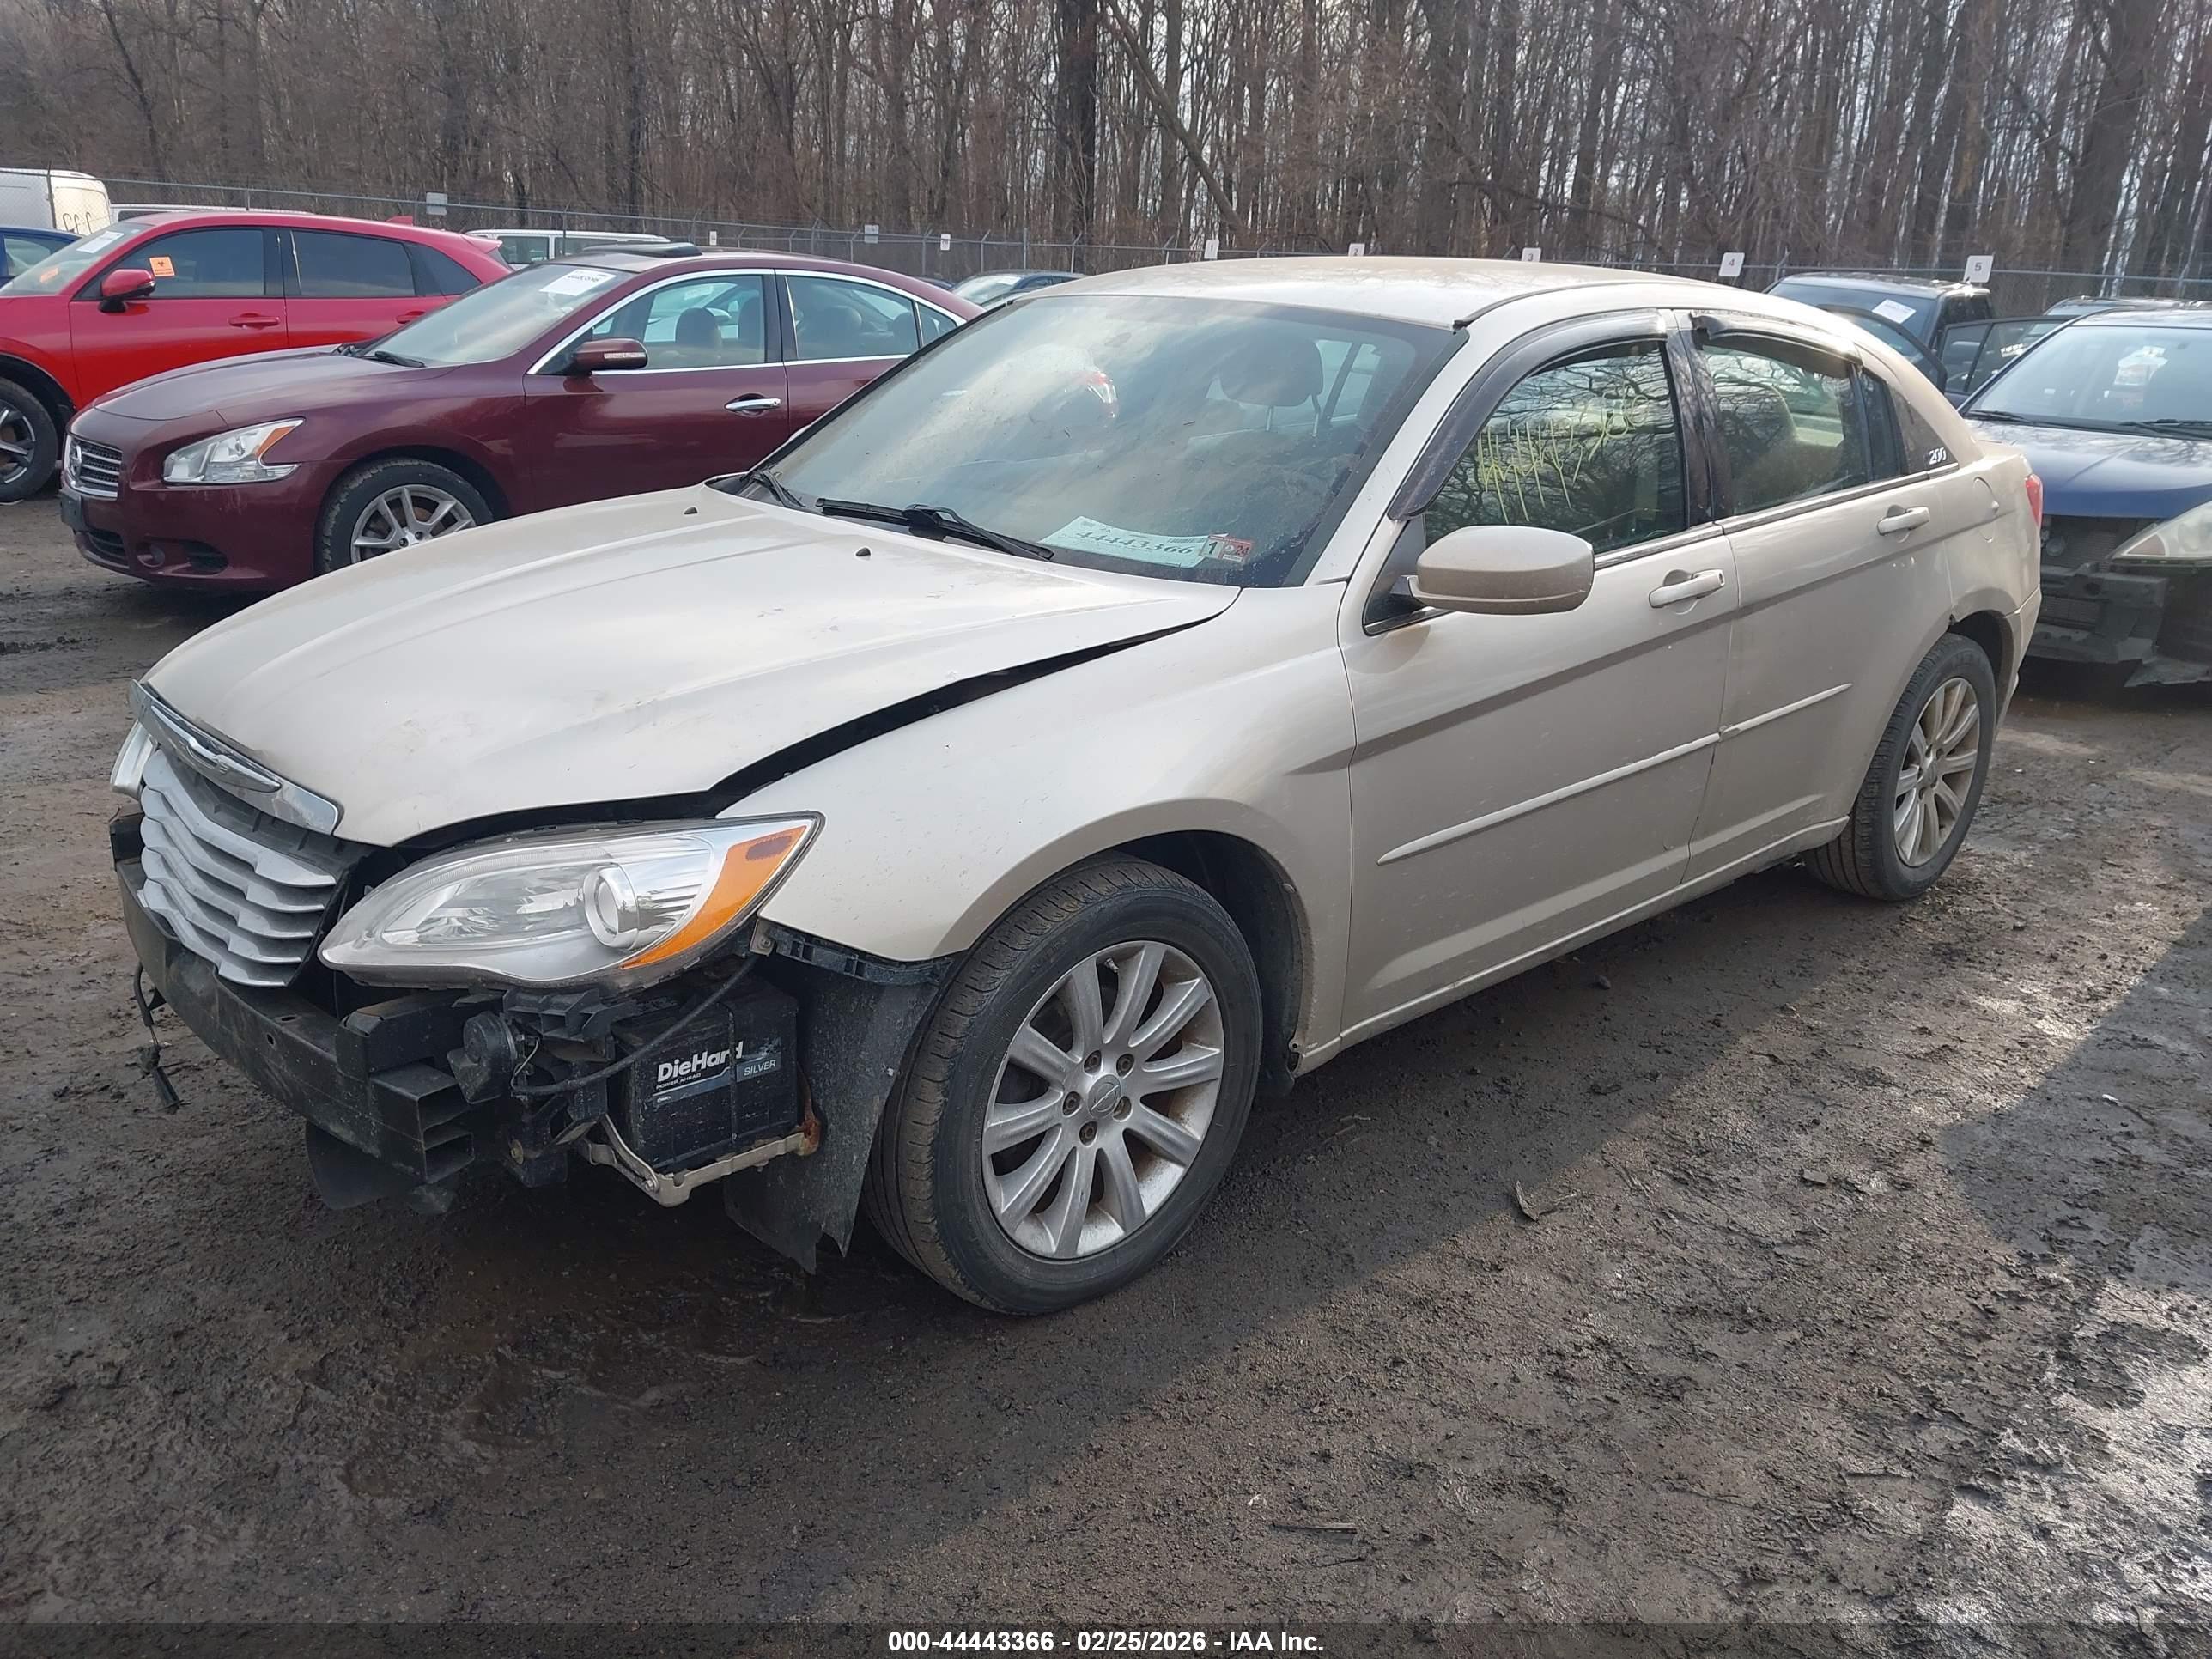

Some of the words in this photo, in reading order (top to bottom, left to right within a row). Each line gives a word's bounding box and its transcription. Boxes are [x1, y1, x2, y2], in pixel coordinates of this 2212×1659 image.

[1975, 261, 1982, 271] 5
[1929, 447, 1947, 465] 200
[1208, 541, 1218, 555] 1
[657, 1041, 744, 1083] DieHard
[744, 1059, 776, 1076] SILVER
[679, 1073, 702, 1083] AHEAD
